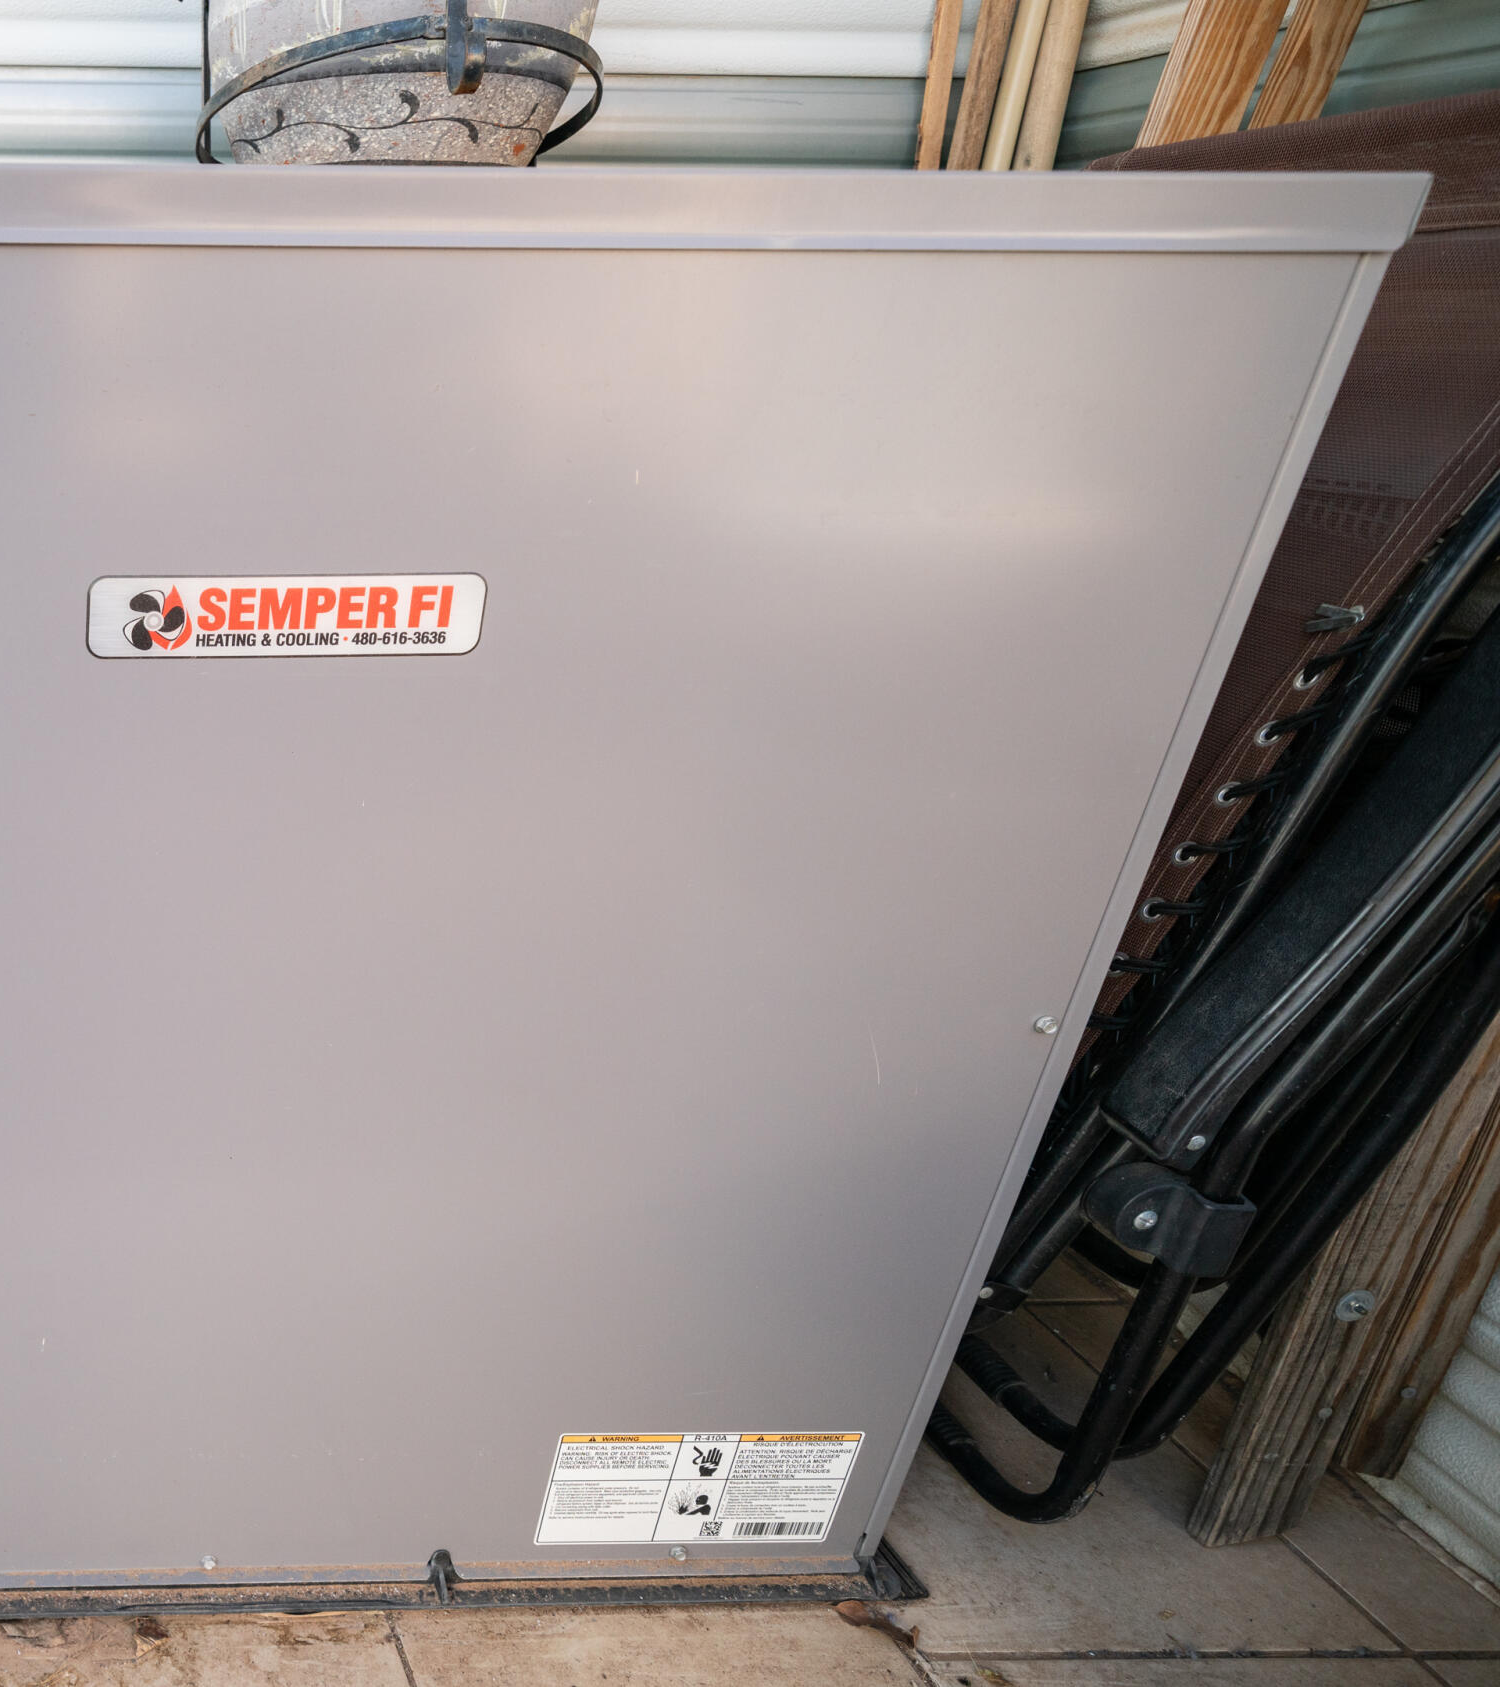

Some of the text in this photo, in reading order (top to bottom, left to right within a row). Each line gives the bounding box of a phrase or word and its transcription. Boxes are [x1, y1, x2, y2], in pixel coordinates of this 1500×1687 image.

[197, 585, 454, 631] SEMPER FI
[195, 631, 447, 647] HEATING & COOLING 480-616-3636
